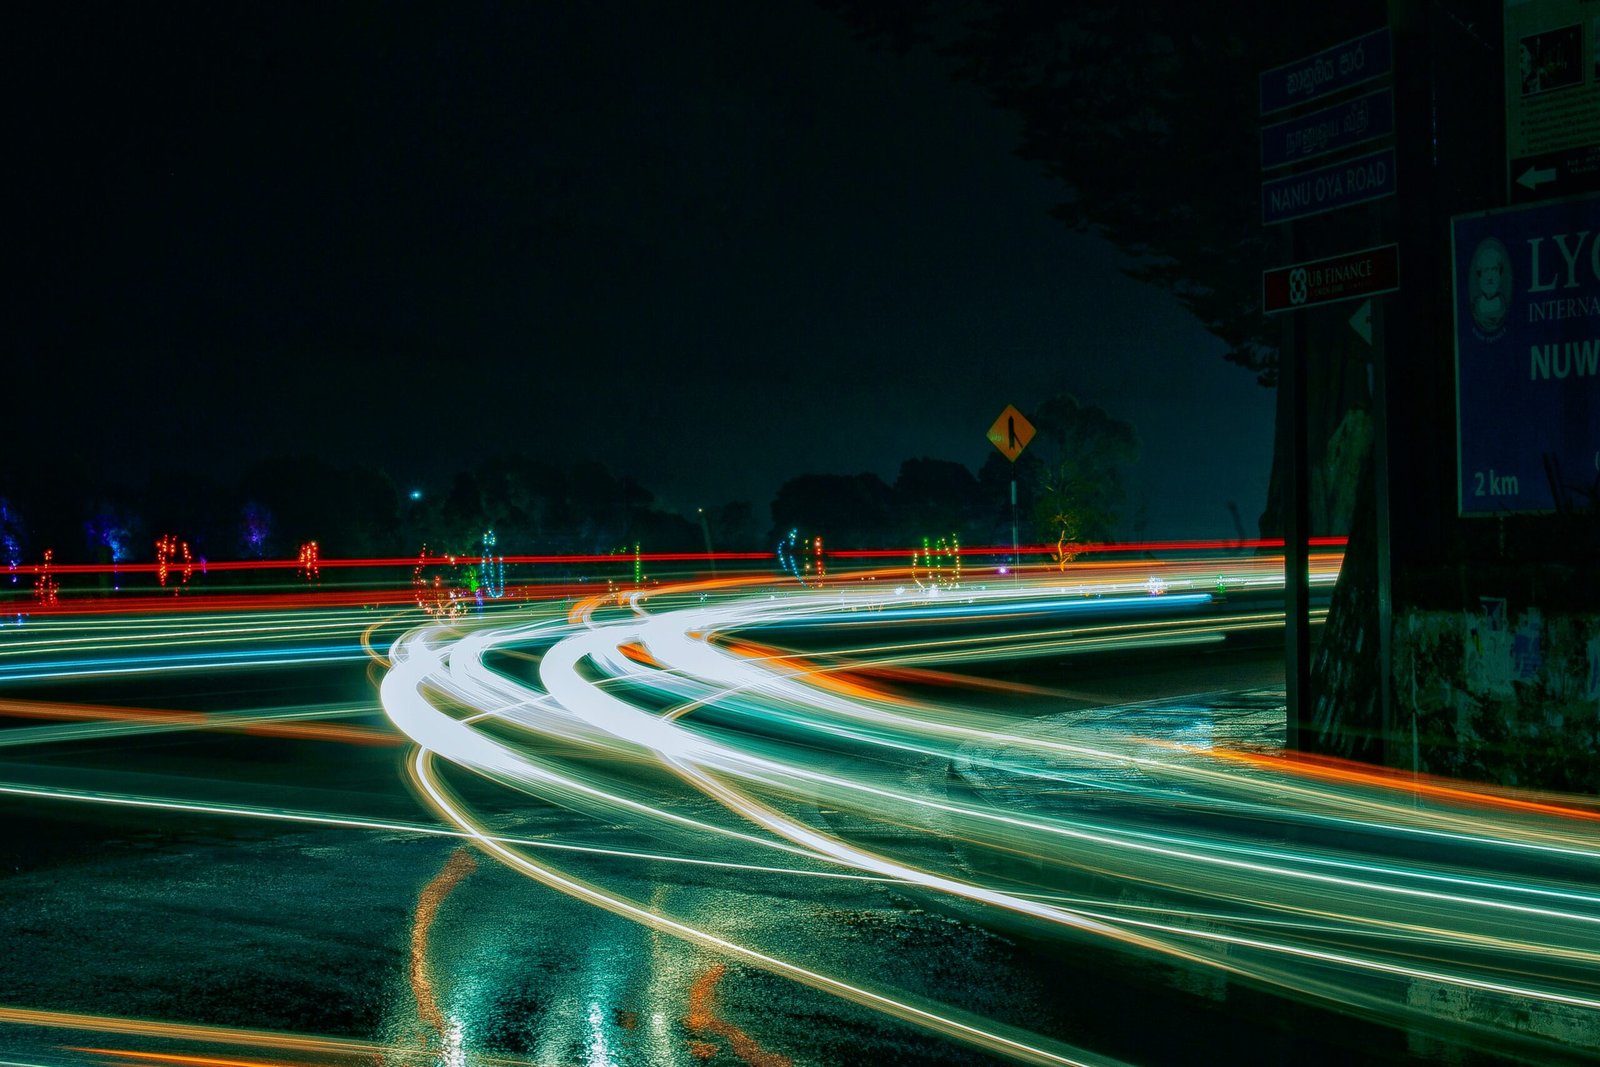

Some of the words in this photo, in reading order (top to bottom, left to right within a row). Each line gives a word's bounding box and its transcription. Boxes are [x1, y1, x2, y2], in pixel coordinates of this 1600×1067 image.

[1271, 181, 1311, 213] NANU
[1316, 174, 1343, 202] OYA
[1347, 161, 1386, 193] ROAD
[1308, 269, 1323, 288] UB
[1325, 259, 1373, 285] FINANCE
[1474, 471, 1486, 497] 2
[1489, 469, 1519, 496] km
